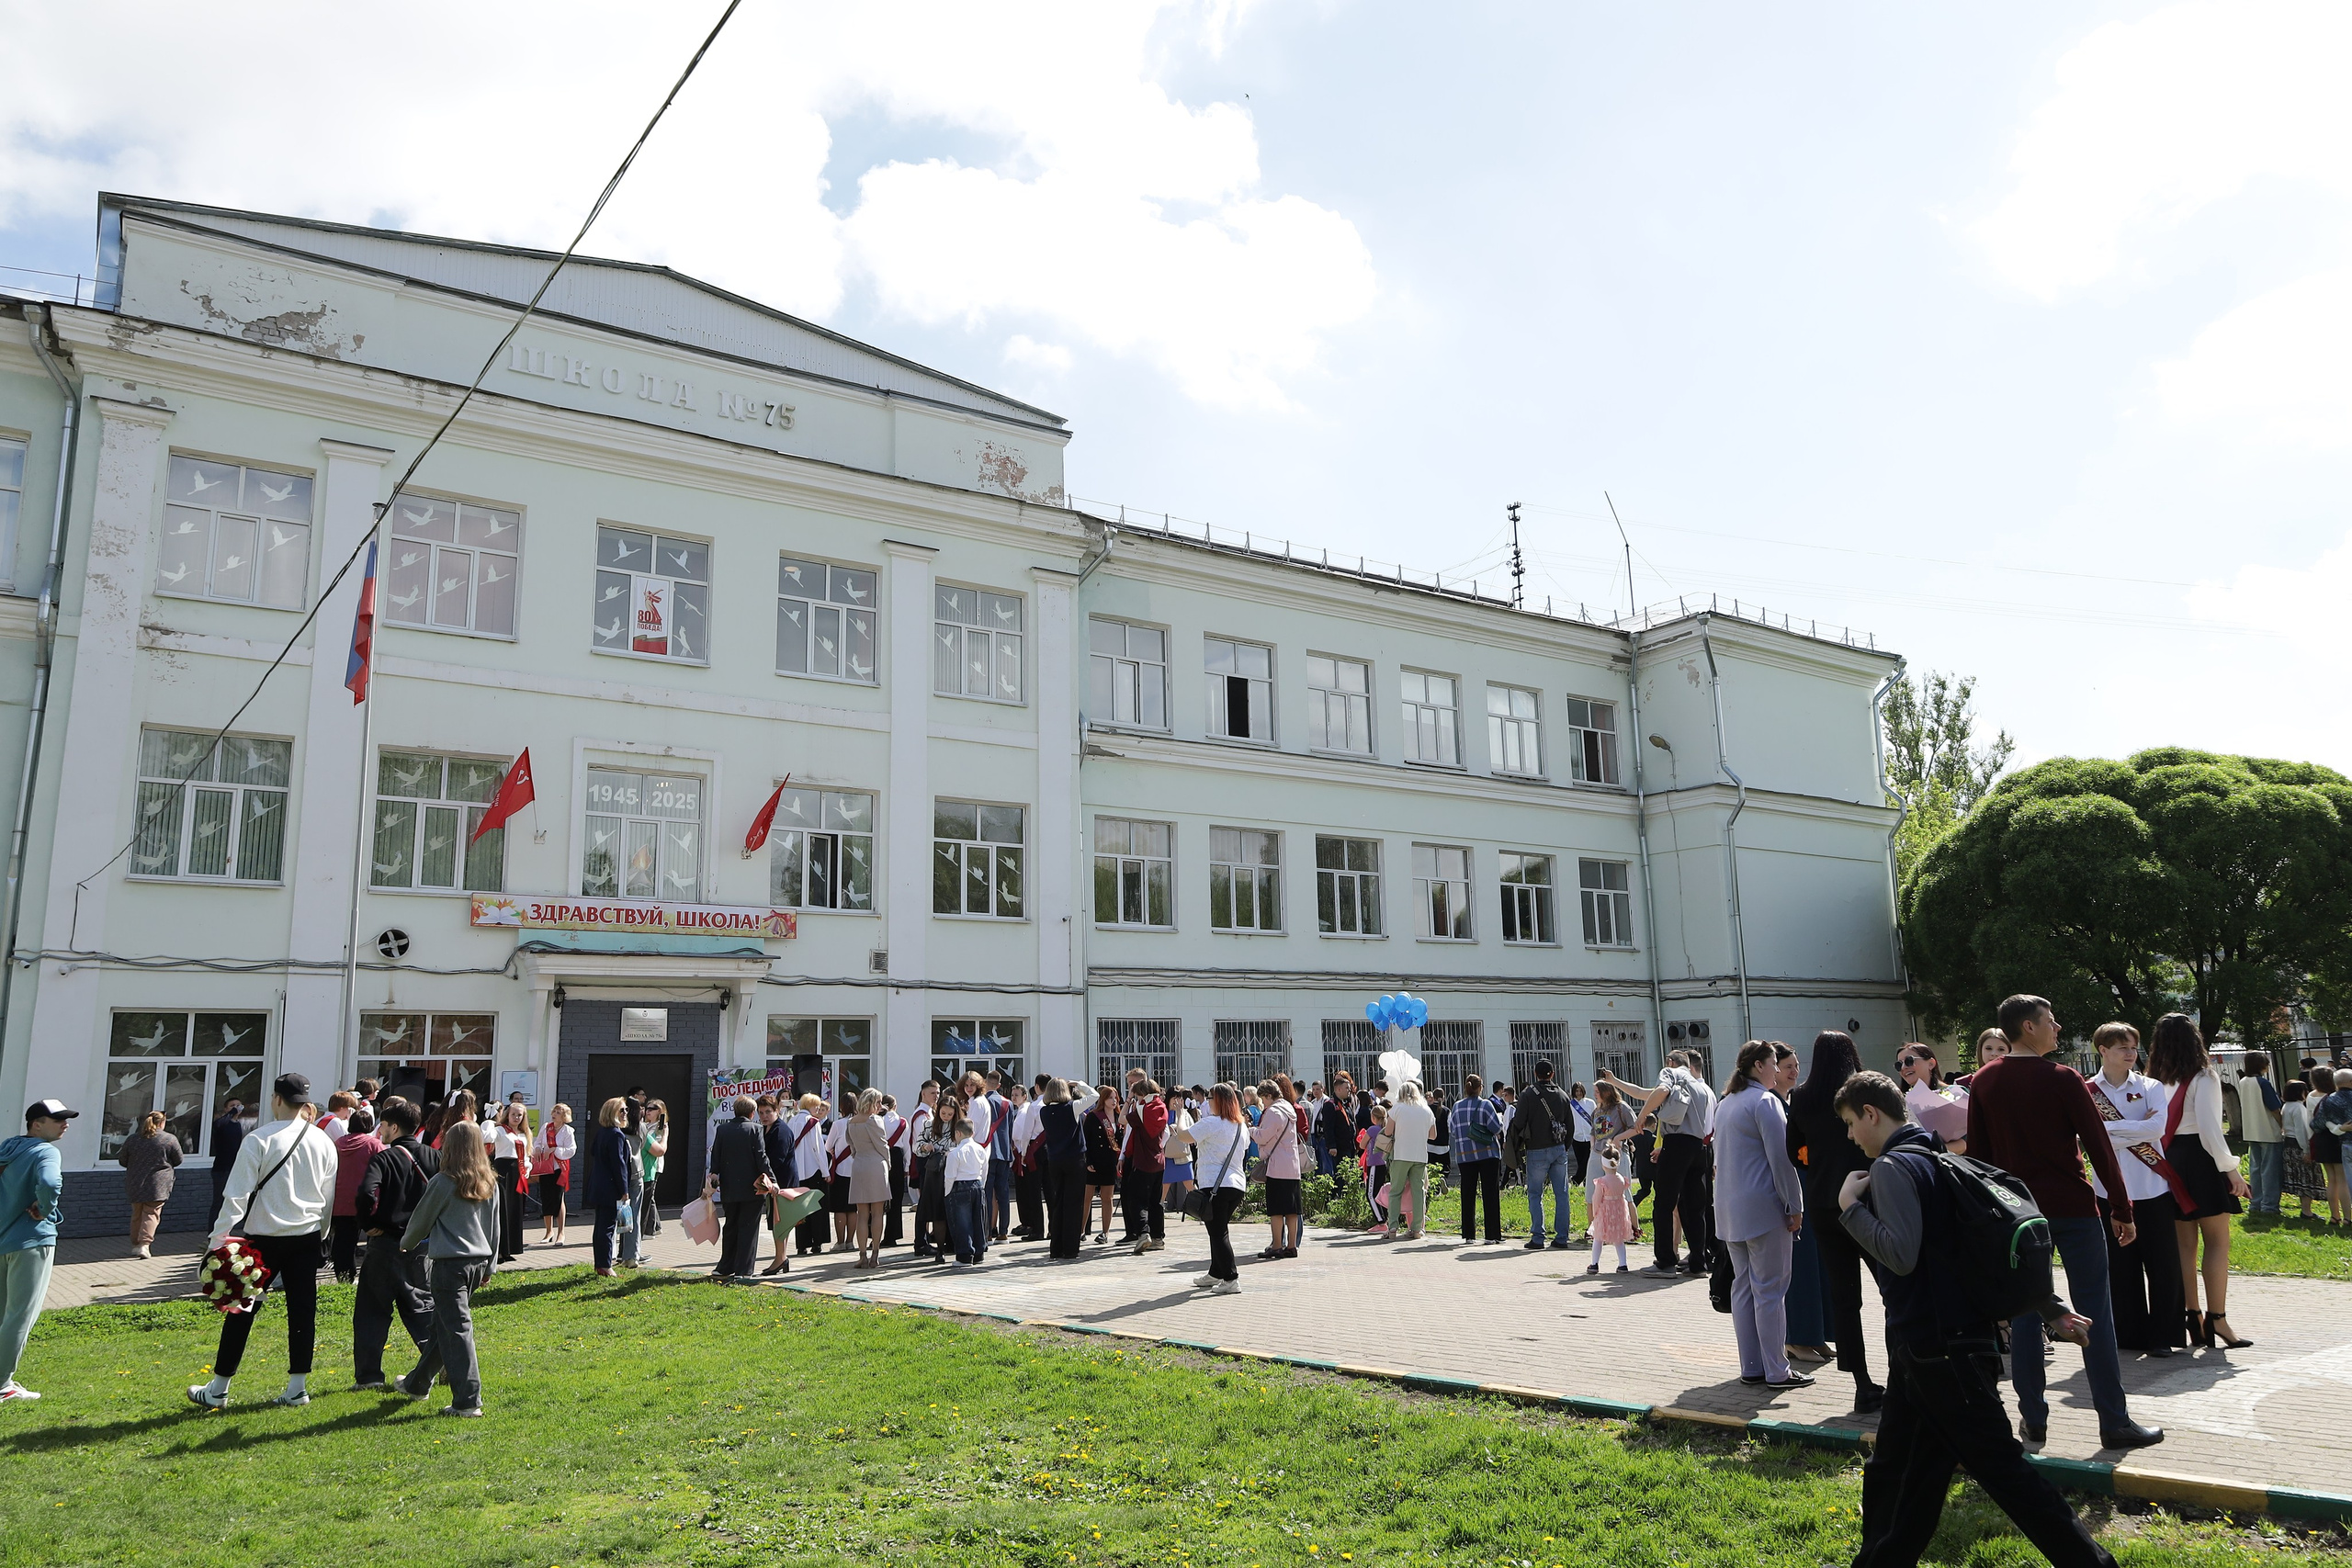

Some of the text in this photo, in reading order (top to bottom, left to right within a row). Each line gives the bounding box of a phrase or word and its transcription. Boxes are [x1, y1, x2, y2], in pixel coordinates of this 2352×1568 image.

[507, 343, 696, 412] ШКОЛА
[637, 623, 662, 632] ПОБЕДА!
[588, 784, 696, 810] 1945 2025
[529, 903, 762, 931] ЗДРАВСТВУЙ, ШКОЛА!
[712, 1075, 786, 1099] ПОСЛЕДНИЙ
